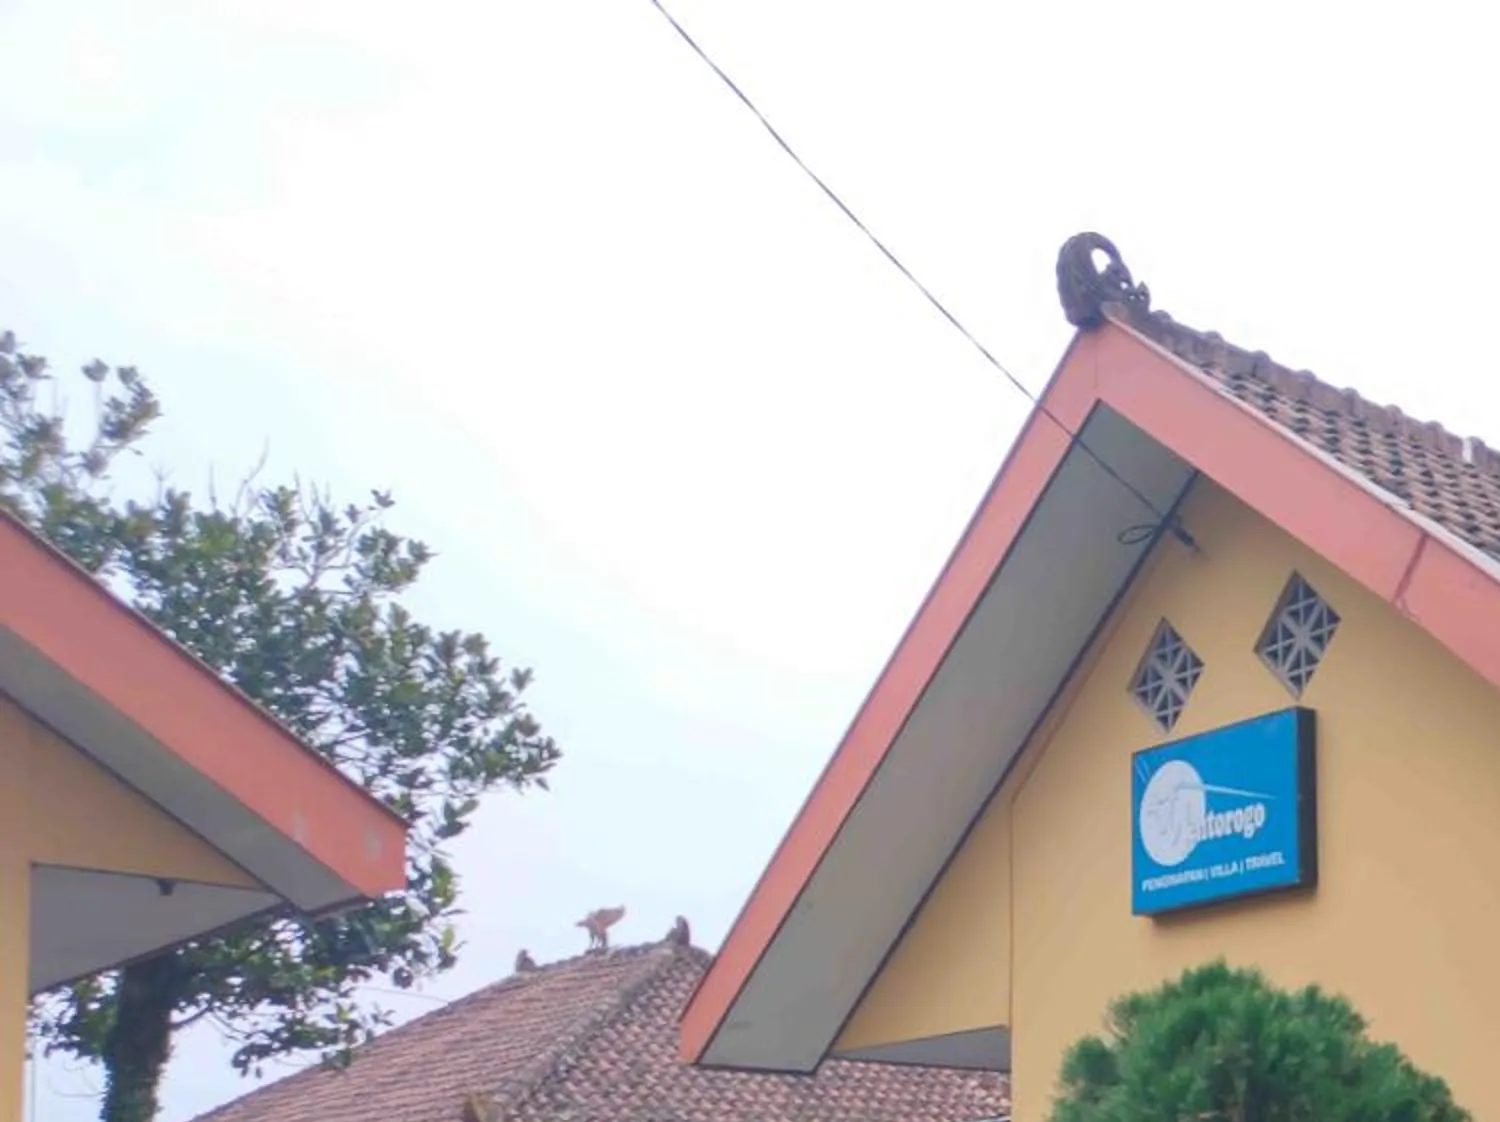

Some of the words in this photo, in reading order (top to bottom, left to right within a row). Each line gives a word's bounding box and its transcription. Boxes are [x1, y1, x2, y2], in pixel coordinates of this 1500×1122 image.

[1142, 867, 1205, 892] PENGINAPAN
[1211, 858, 1239, 877] VILLA
[1246, 851, 1286, 871] TRAVEL
